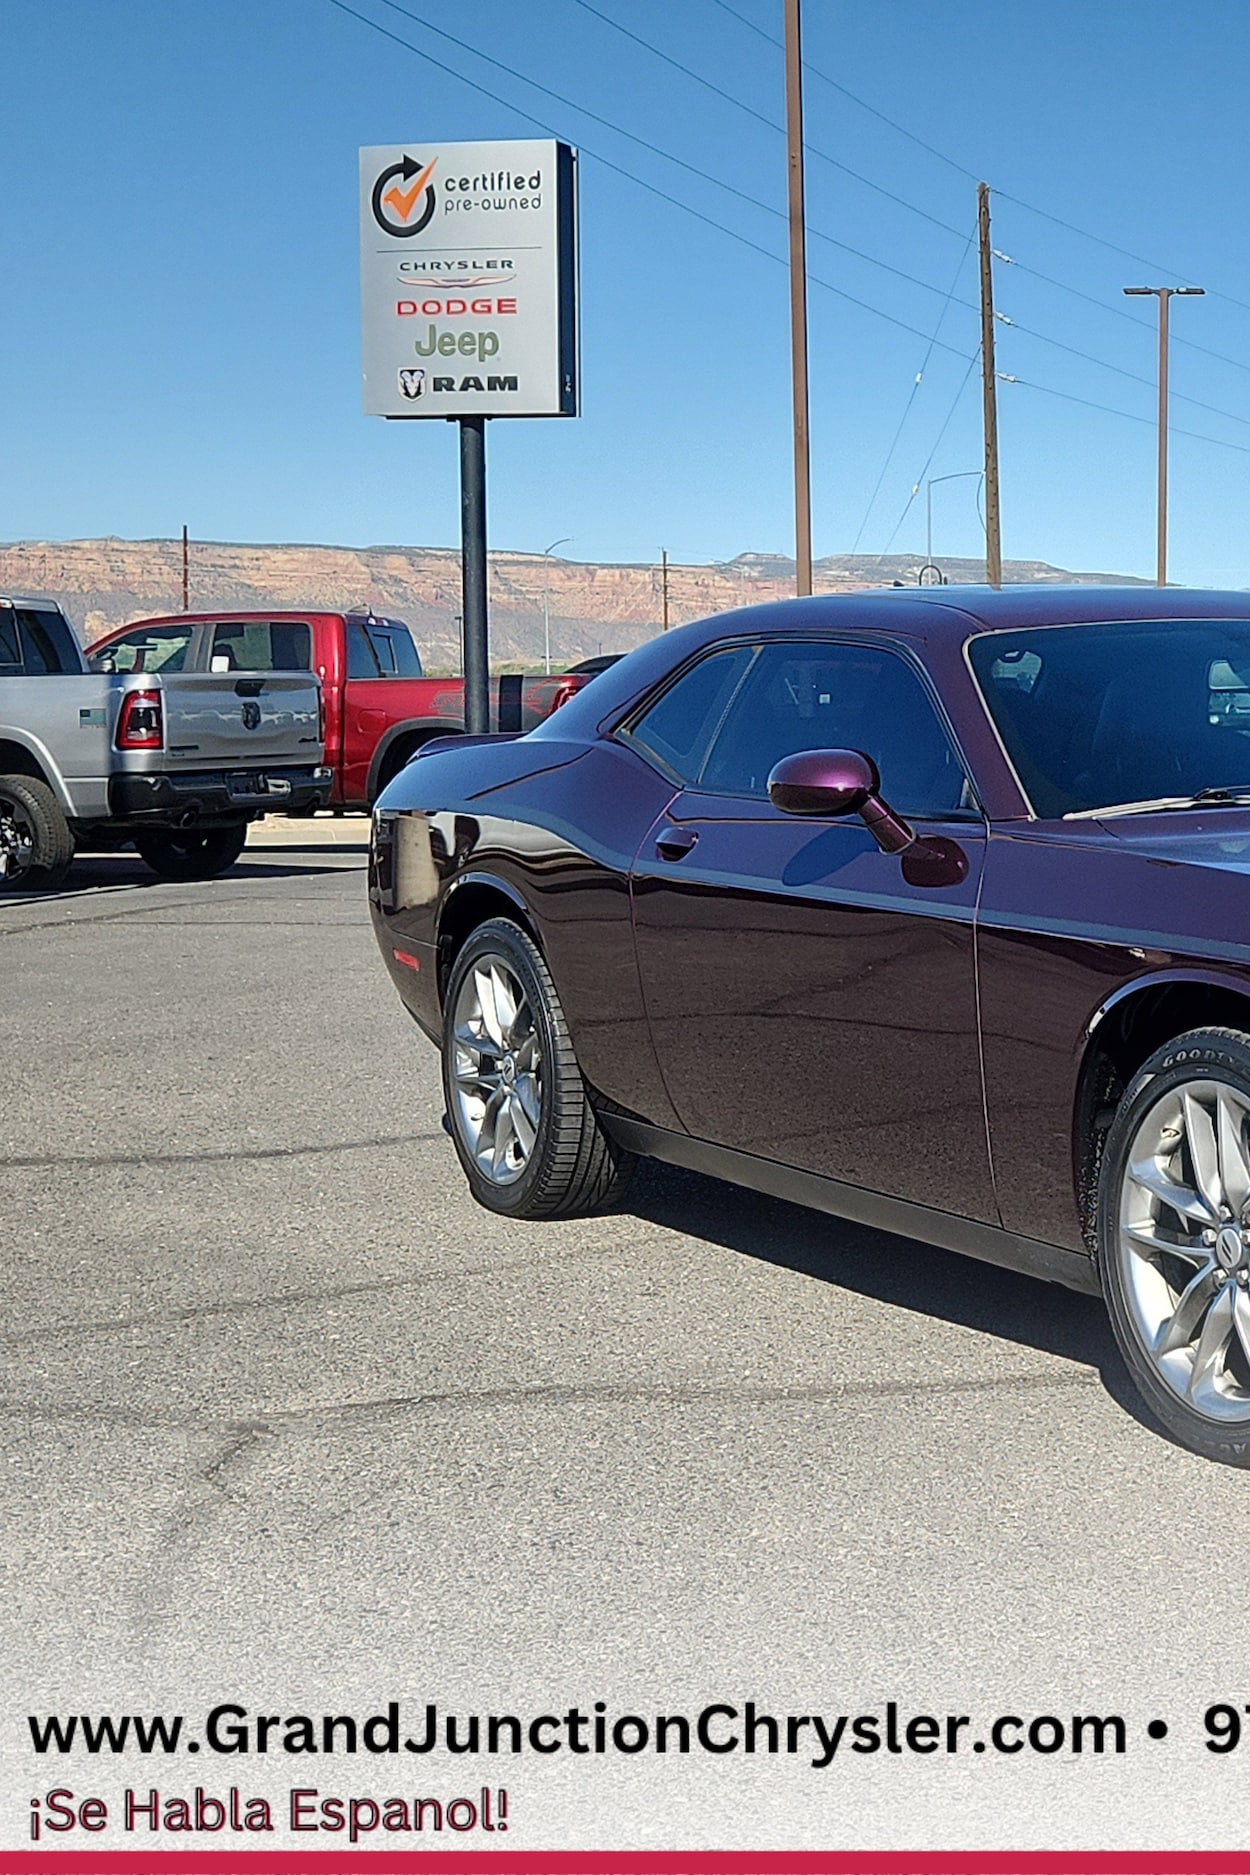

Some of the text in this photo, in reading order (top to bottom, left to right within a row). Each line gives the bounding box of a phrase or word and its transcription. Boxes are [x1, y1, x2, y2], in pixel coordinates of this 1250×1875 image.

[444, 170, 541, 192] certified
[444, 194, 542, 216] pre-owned
[399, 259, 514, 271] CHRYSLER
[396, 298, 518, 316] DODGE
[414, 323, 500, 362] Jeep
[432, 375, 519, 392] RAM
